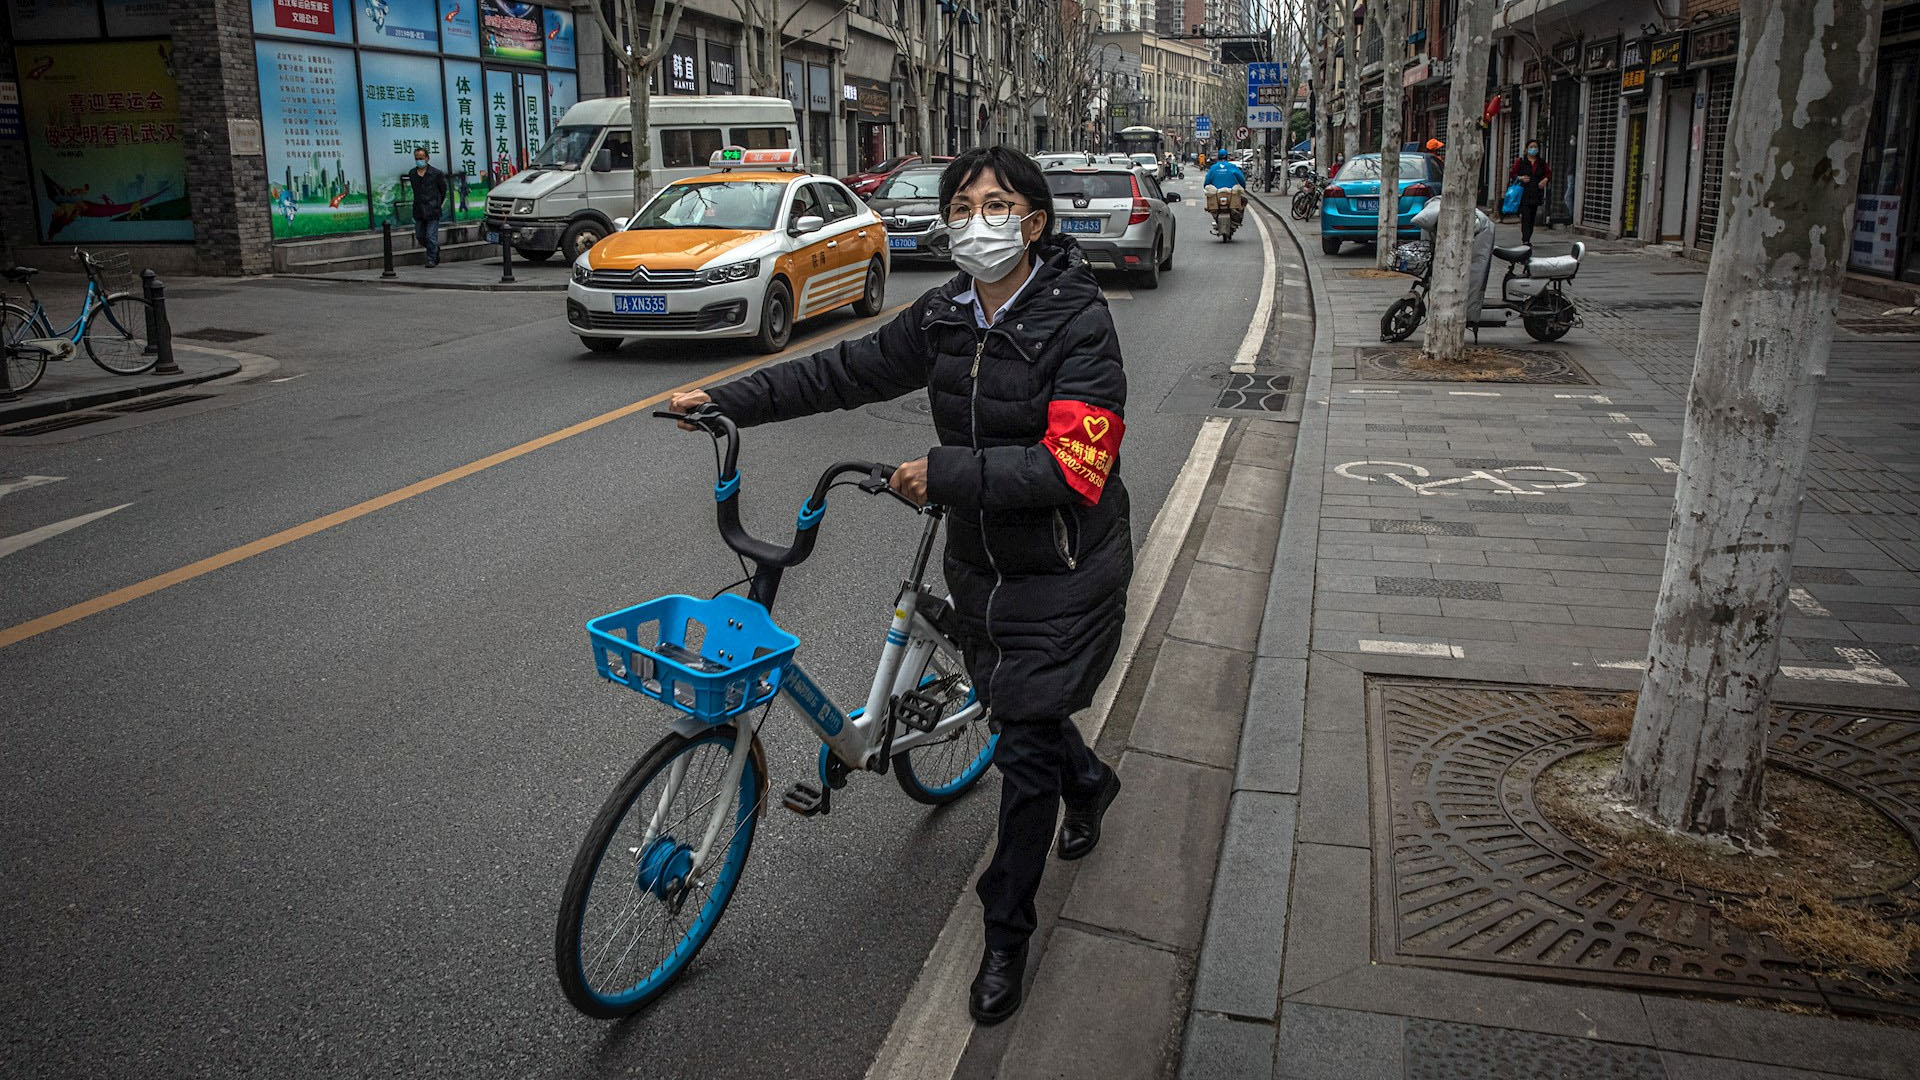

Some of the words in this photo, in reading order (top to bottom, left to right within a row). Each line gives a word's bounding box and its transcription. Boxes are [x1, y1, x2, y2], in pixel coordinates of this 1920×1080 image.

[69, 91, 164, 113] 喜迎军运会
[366, 84, 415, 102] 迎接军运会
[382, 112, 430, 128] 打造新环境
[456, 76, 476, 177] 体育传友谊
[1258, 111, 1283, 123] 黎黄陂
[45, 122, 177, 145] 做文明有礼武汉
[493, 91, 510, 174] 共享友谊
[527, 96, 540, 163] 同筑和
[723, 150, 741, 160] 空车
